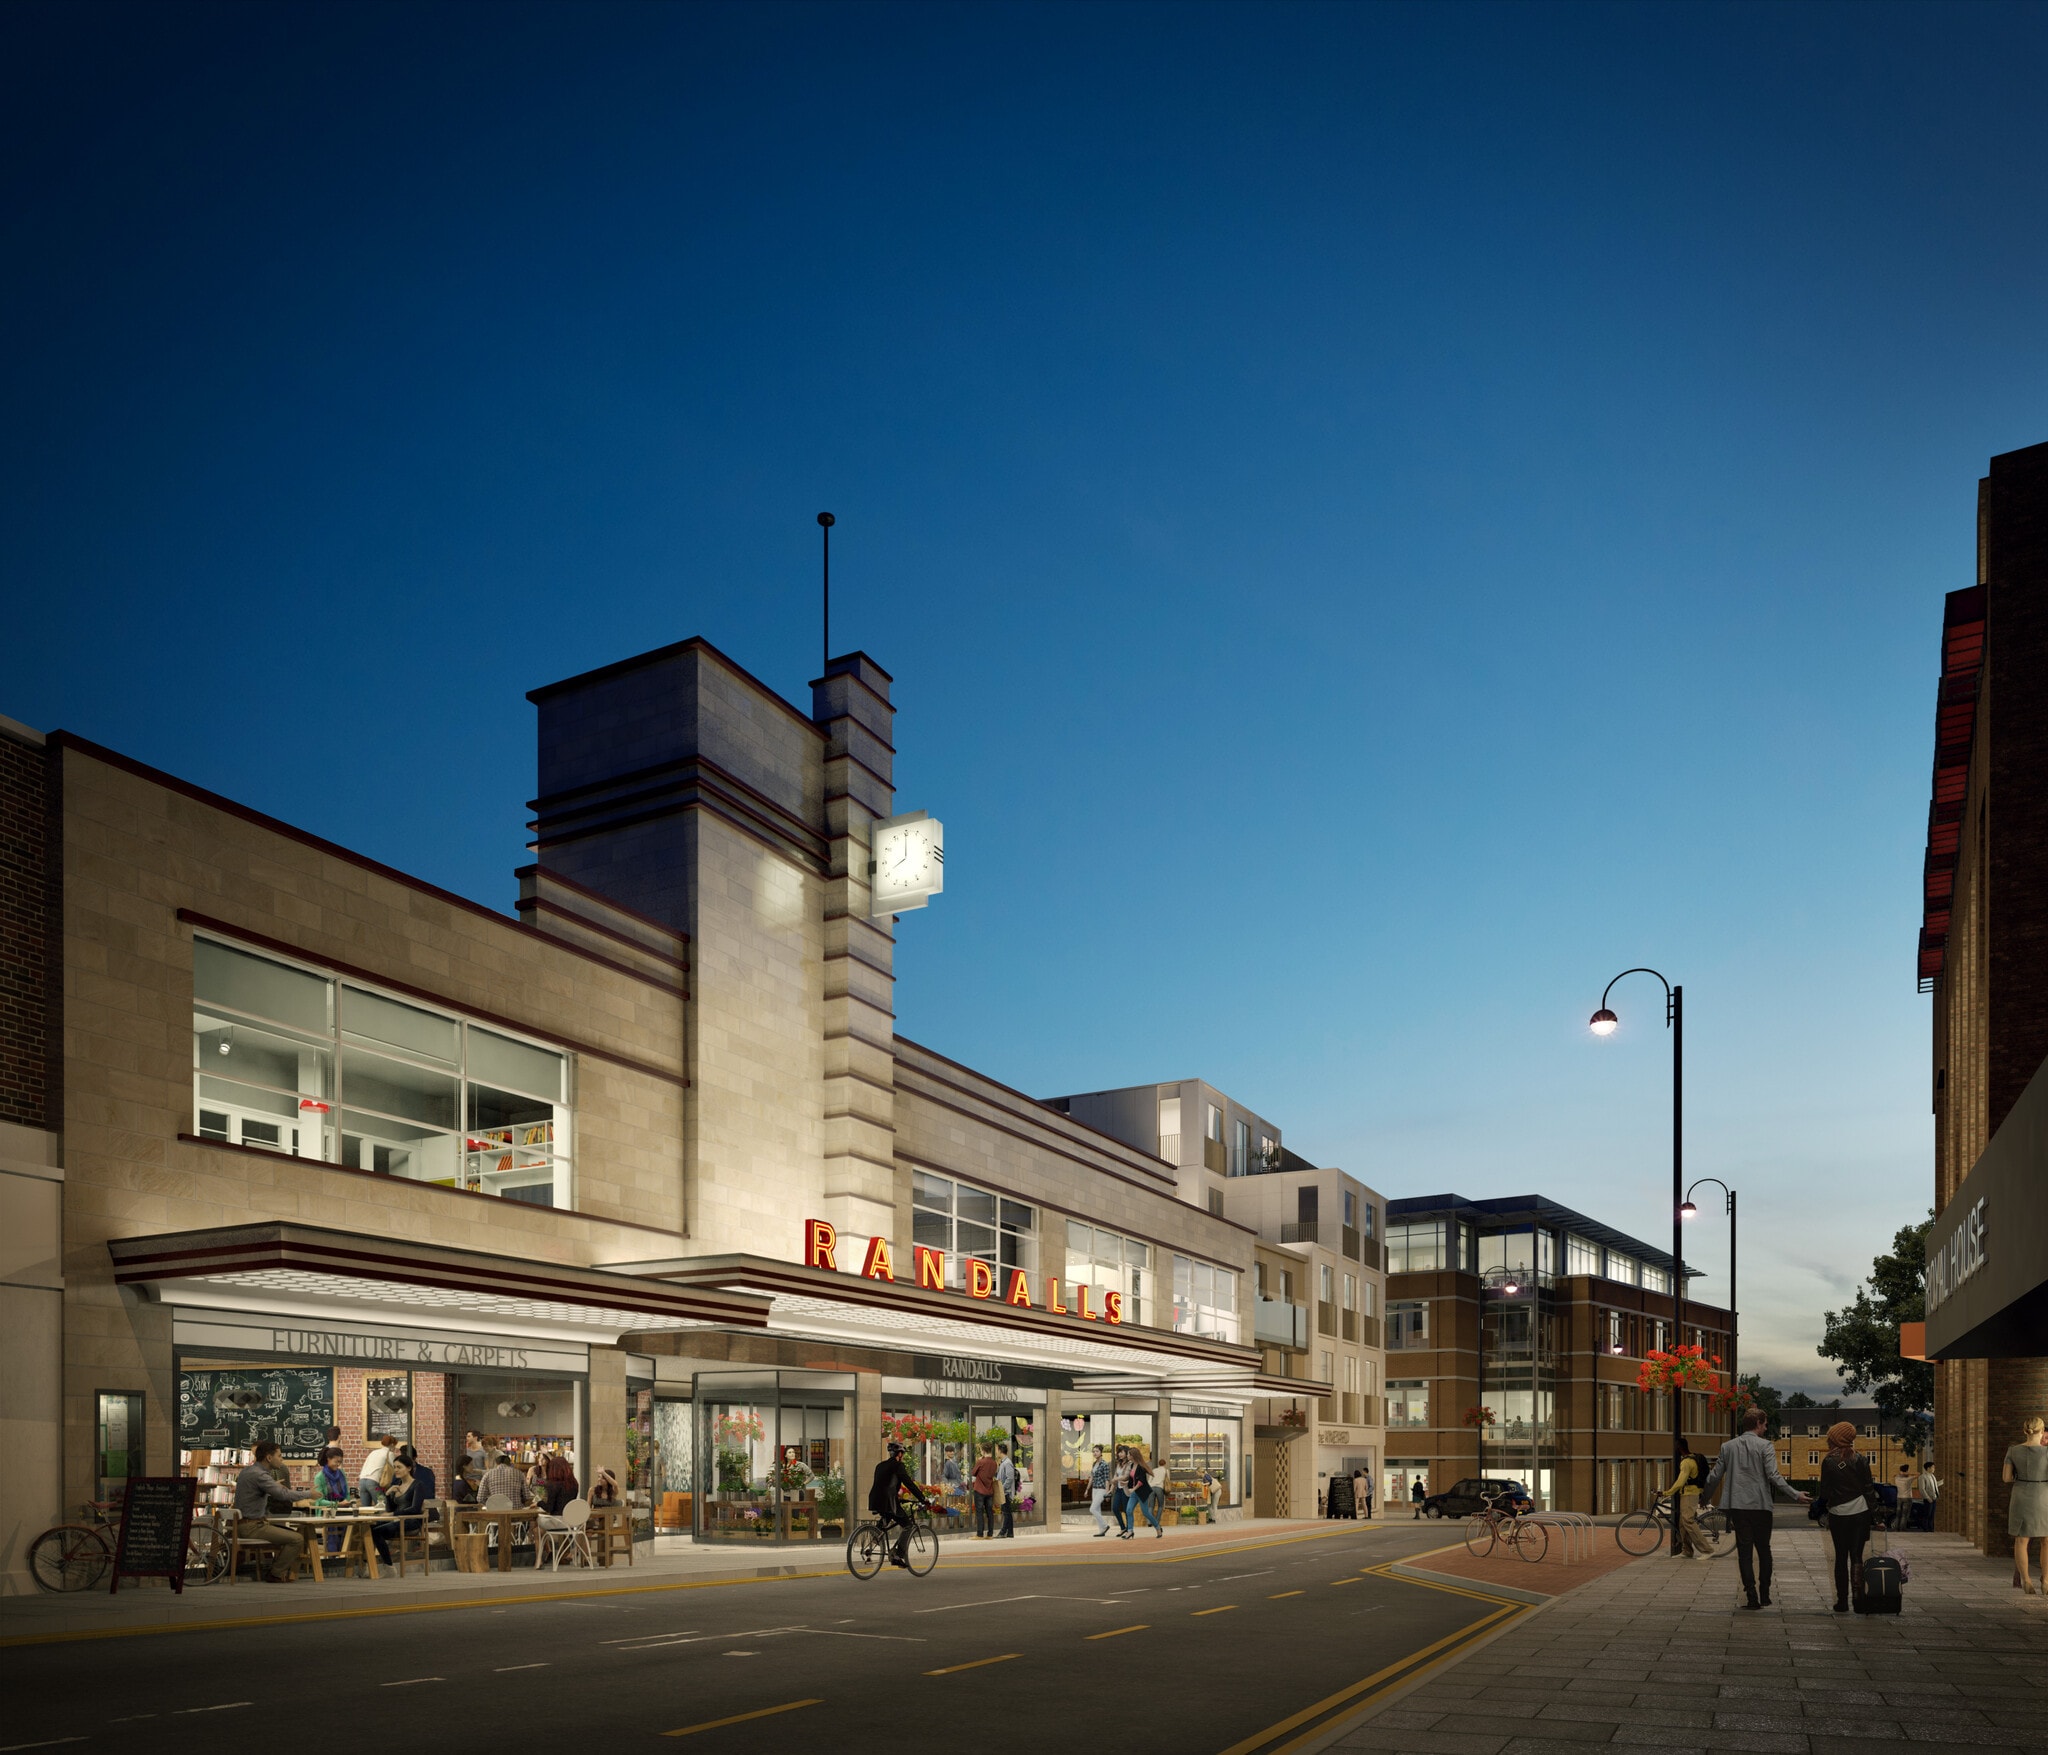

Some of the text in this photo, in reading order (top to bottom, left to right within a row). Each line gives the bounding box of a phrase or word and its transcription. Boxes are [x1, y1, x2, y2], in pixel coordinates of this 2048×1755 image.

[805, 1218, 1122, 1325] RANDALLS
[1925, 1195, 1988, 1316] ROYAL HOUSE
[272, 1329, 528, 1369] FURNITURE & CARPETS
[942, 1357, 1002, 1382] RANDALLS
[923, 1379, 1018, 1402] SOFT FURNISHINGS
